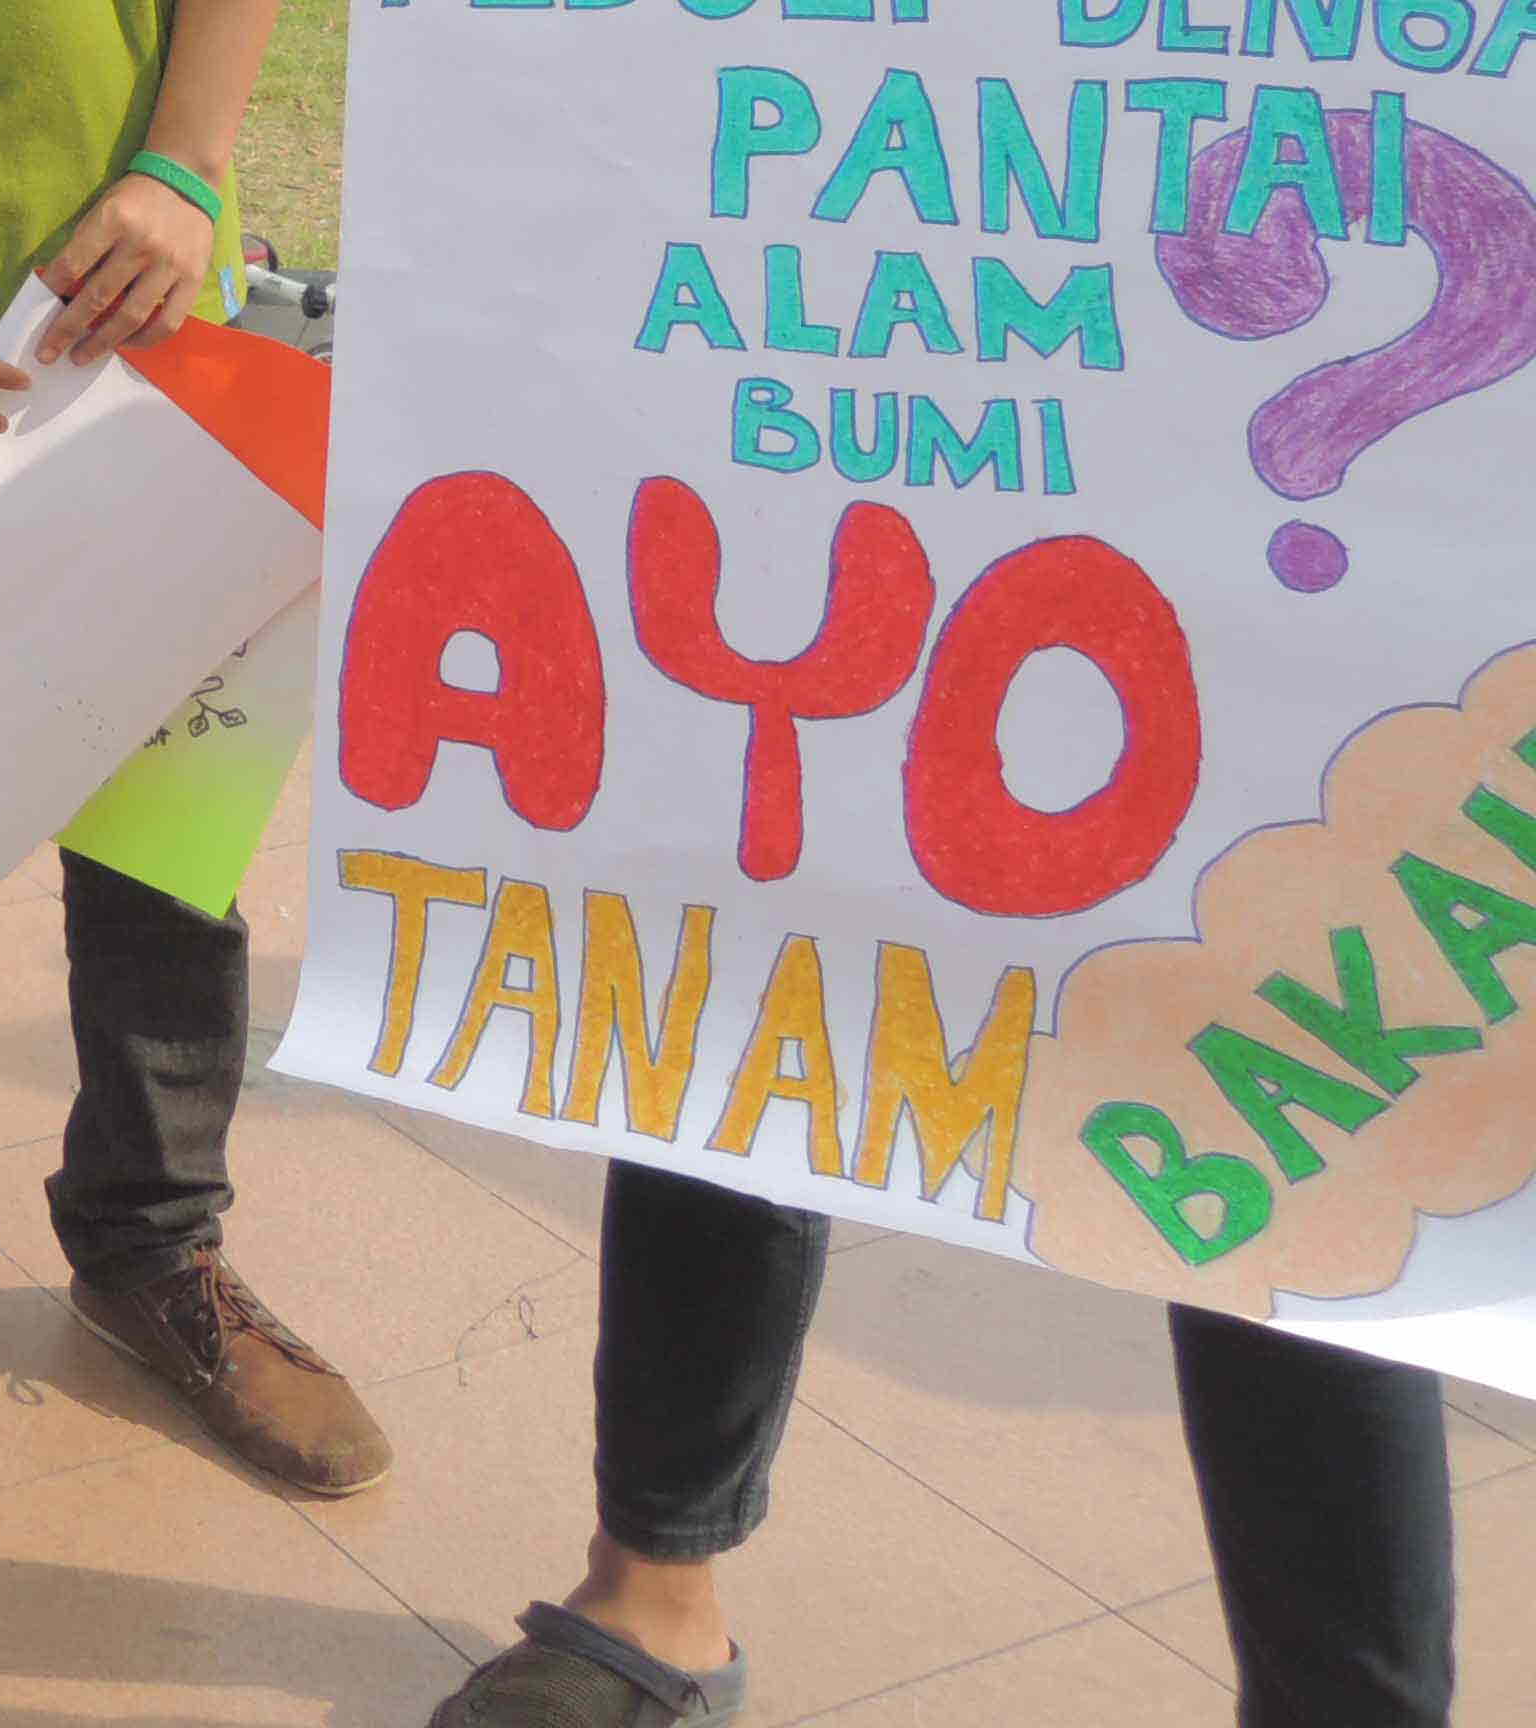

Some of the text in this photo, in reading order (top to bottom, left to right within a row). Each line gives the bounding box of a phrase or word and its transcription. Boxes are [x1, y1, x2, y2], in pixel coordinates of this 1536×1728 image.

[709, 66, 1406, 247] PANTAI
[634, 241, 1125, 371] ALAM
[731, 377, 1077, 495] BUMI
[337, 469, 1202, 918] AYO
[336, 847, 1038, 1223] TANAM
